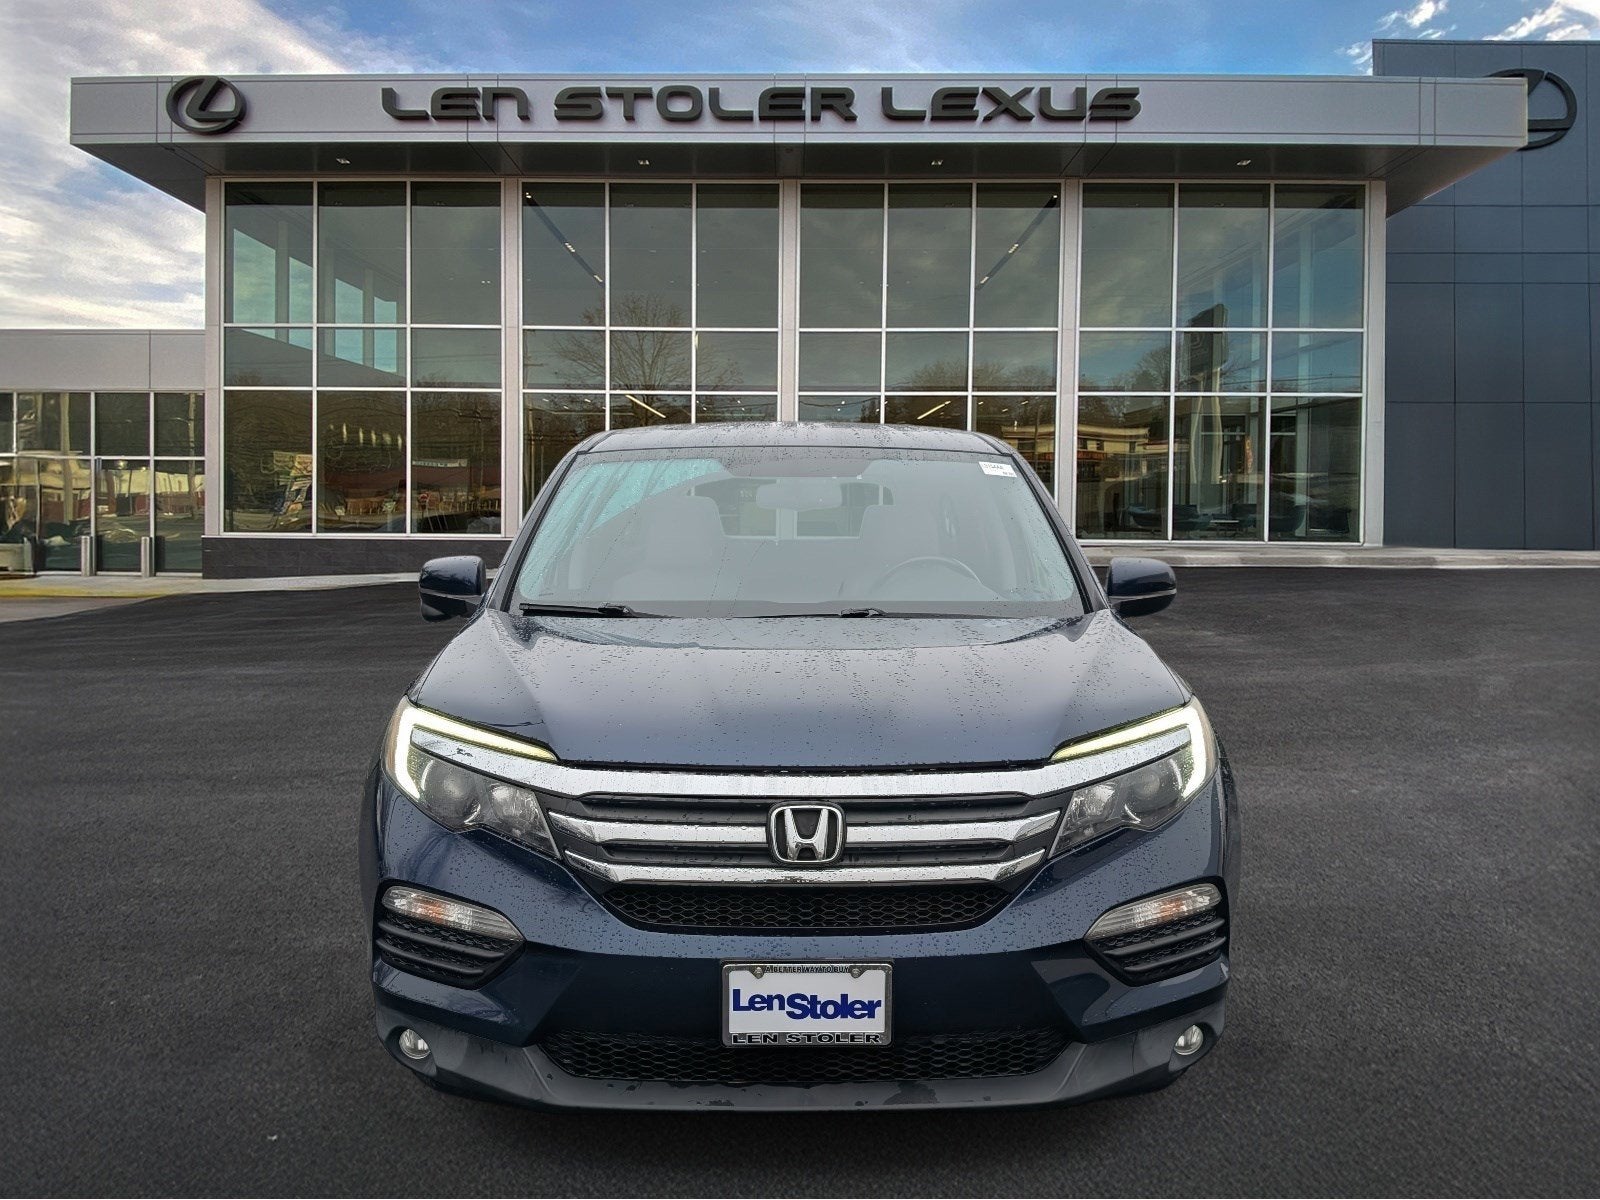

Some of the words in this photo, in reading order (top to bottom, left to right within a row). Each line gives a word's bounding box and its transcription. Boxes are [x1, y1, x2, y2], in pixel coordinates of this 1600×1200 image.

[381, 87, 530, 121] LEN
[554, 85, 857, 122] STOLER
[881, 86, 1141, 122] LEXUS
[732, 1033, 778, 1044] LEN
[786, 1033, 882, 1044] STOLER
